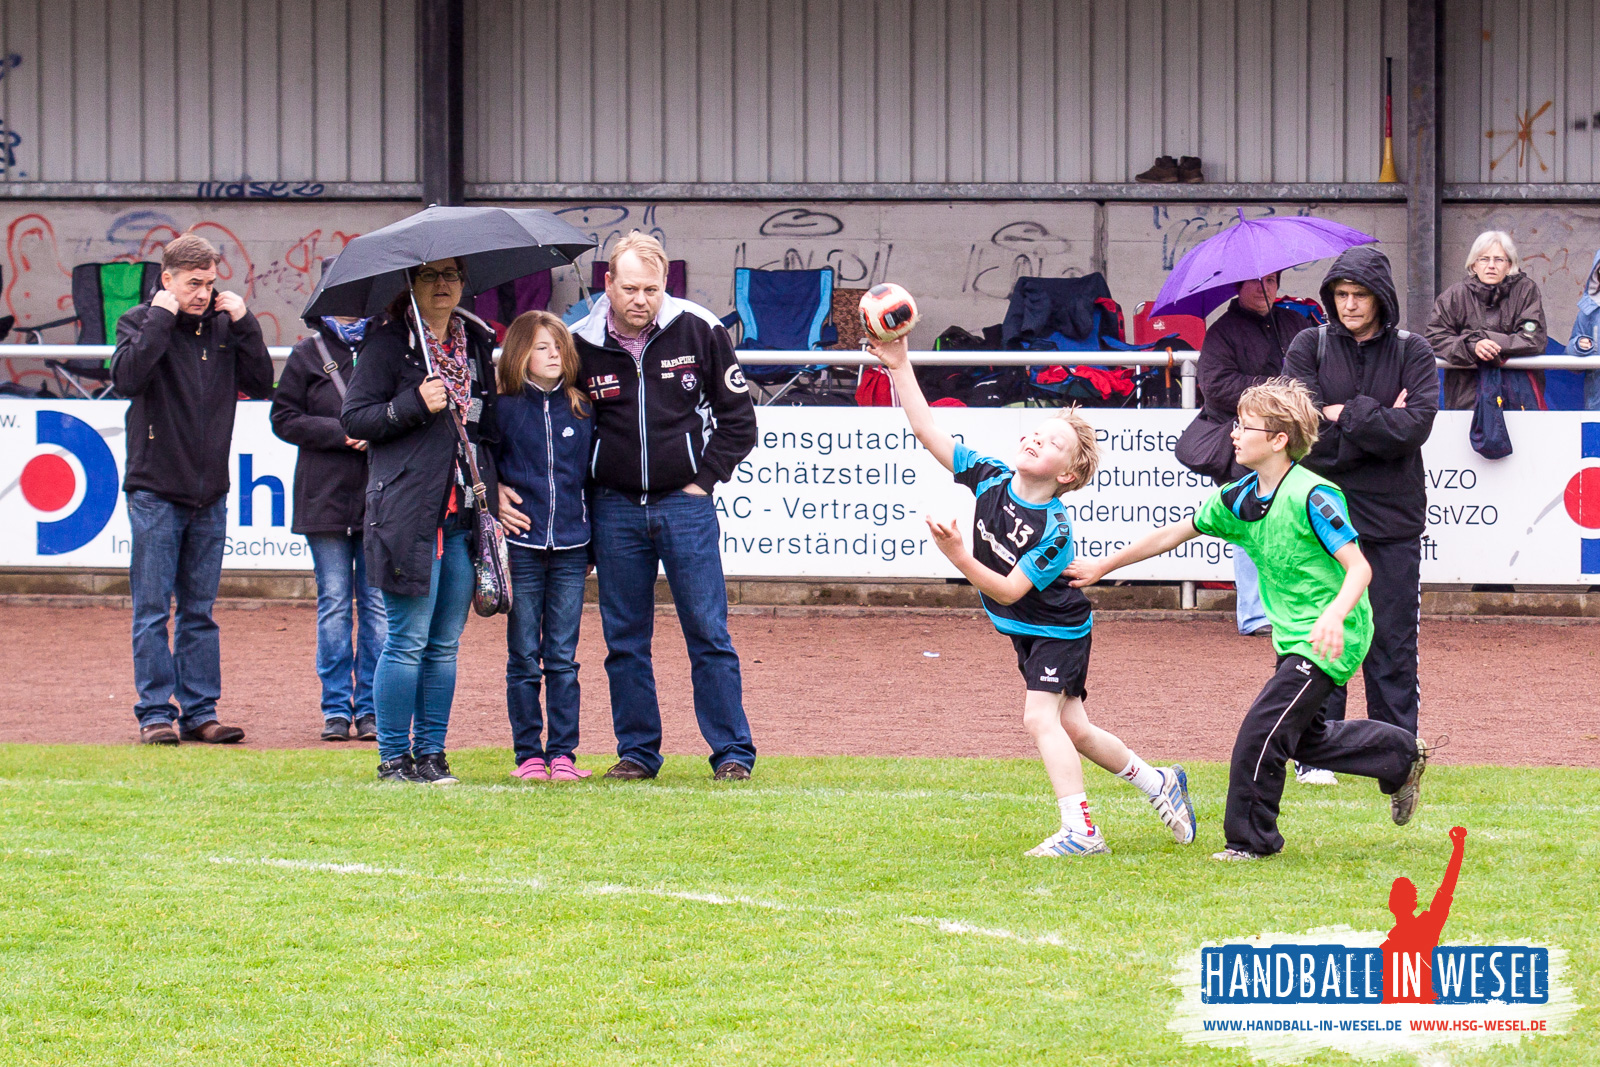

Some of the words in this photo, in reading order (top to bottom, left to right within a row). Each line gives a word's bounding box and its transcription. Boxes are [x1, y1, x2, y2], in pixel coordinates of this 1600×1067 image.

[756, 427, 964, 454] ensgutachn
[1094, 429, 1184, 452] Prüfste
[737, 461, 916, 485] Schätzstelle
[1087, 466, 1217, 492] ptuntersu
[226, 454, 285, 526] h
[715, 496, 752, 518] AC
[783, 497, 916, 525] Vertrags-
[1064, 500, 1202, 528] nderungsa
[1427, 505, 1498, 525] StVZO
[112, 535, 131, 553] In
[224, 536, 311, 557] Sachver
[724, 531, 928, 561] hverständiger
[1006, 518, 1035, 548] 13
[1422, 538, 1437, 560] ft
[1040, 675, 1059, 683] erima
